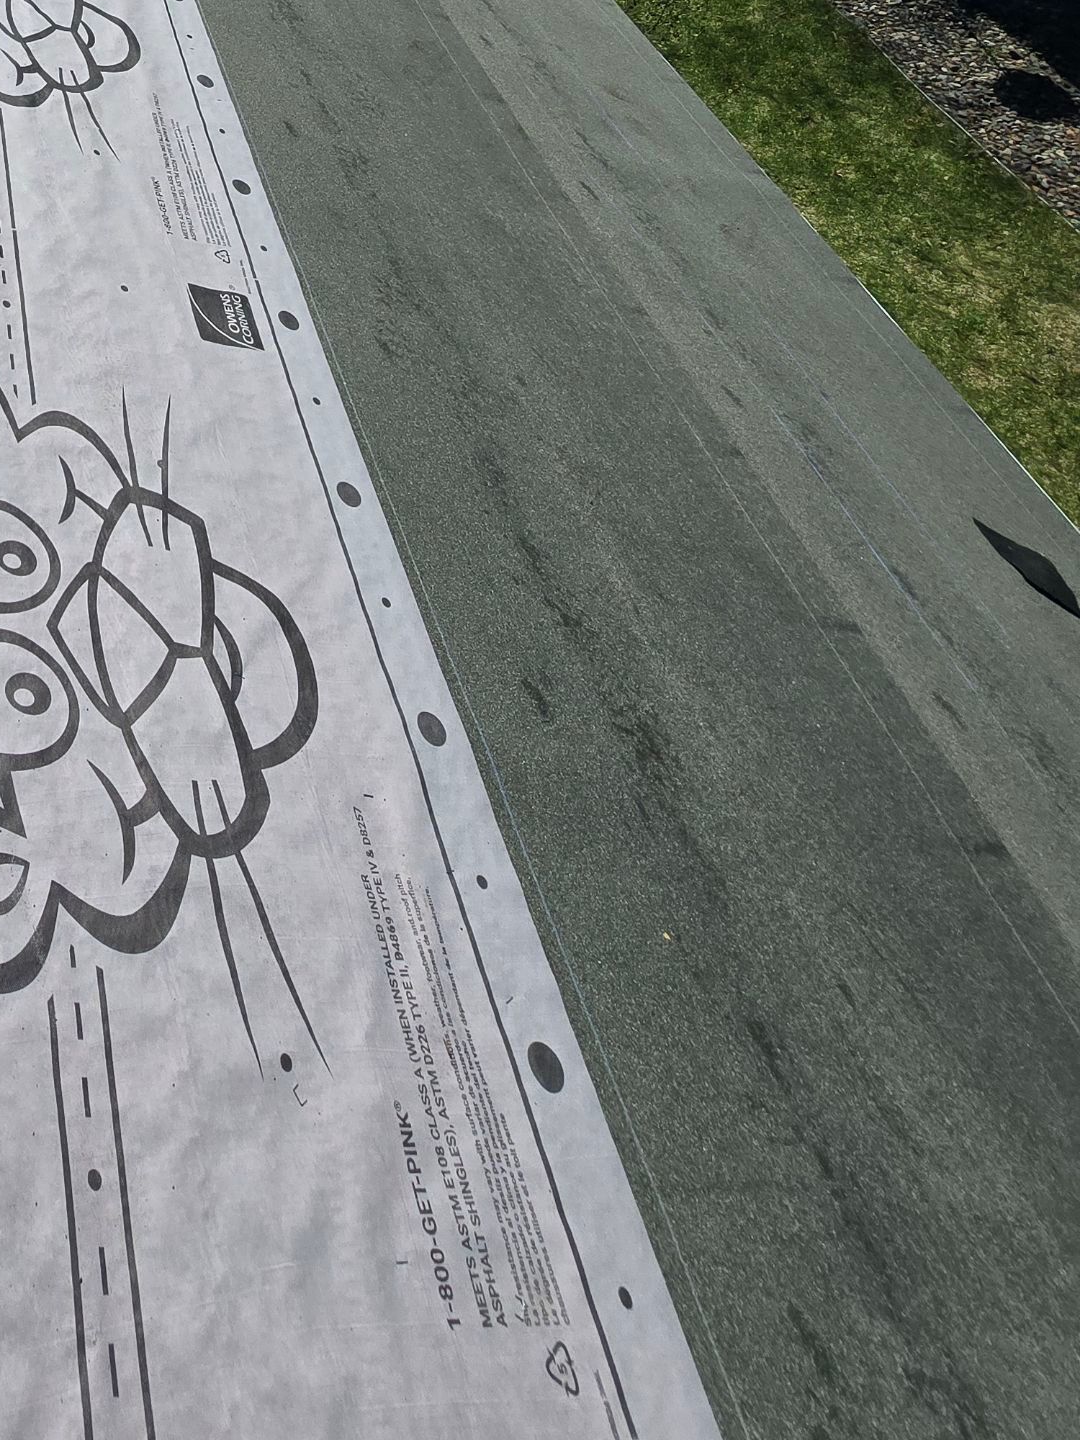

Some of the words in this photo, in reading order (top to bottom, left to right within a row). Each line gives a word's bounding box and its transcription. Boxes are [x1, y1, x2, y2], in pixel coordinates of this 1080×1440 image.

[220, 293, 241, 334] OWENS
[231, 295, 255, 345] CORNING
[365, 849, 374, 857] &
[368, 861, 379, 874] IV
[360, 874, 380, 919] UNDER
[372, 878, 390, 912] TYPE
[373, 924, 404, 1003] INSTALLED
[401, 981, 421, 1019] TYPE
[397, 1008, 421, 1062] (WHEN
[413, 1024, 434, 1064] D226
[412, 1067, 425, 1079] A
[426, 1070, 449, 1120] ASTM
[417, 1083, 441, 1140] CLASS
[434, 1146, 455, 1188] E108
[441, 1124, 482, 1226] SHINGLES),
[447, 1194, 472, 1250] ASTM
[463, 1255, 493, 1327] MEETS
[471, 1231, 509, 1327] ASPHALT
